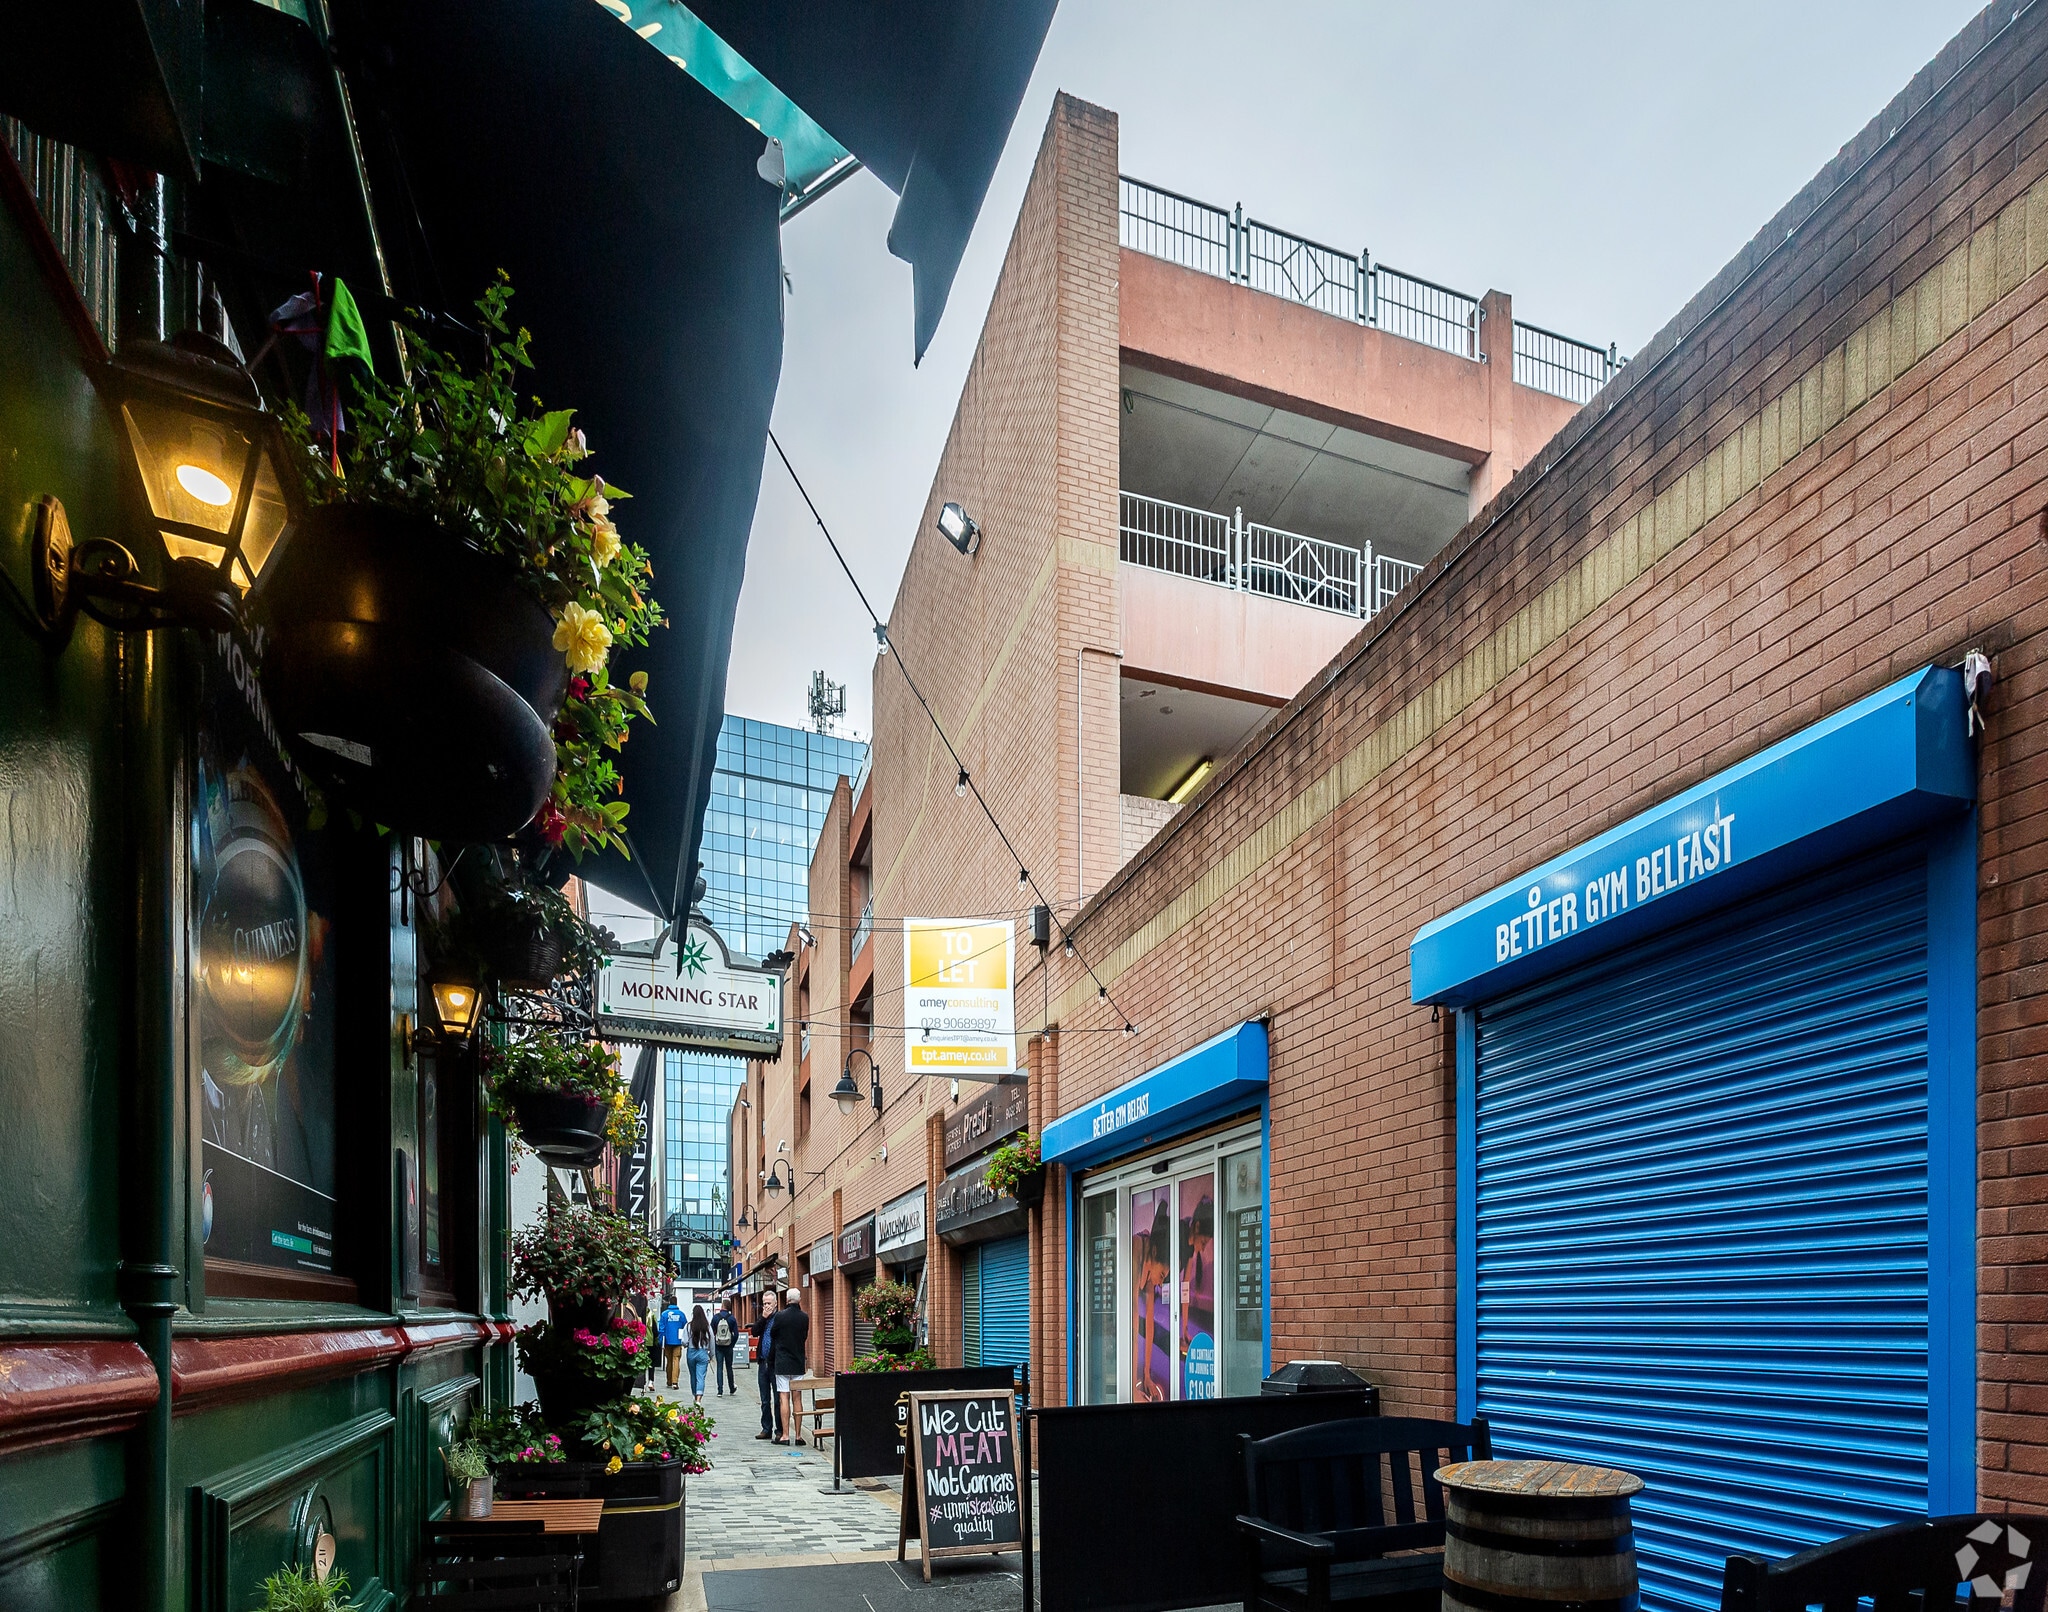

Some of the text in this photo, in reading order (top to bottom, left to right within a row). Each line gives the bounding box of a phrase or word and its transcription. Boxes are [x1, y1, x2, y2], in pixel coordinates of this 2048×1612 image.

[1496, 813, 1735, 963] BETTER GYM BELFAST
[941, 931, 973, 955] TO
[938, 959, 979, 983] LET
[621, 981, 758, 1010] MORNING STAR
[919, 997, 999, 1011] ameyconsulting
[920, 1017, 997, 1030] 028 90689897
[921, 1049, 997, 1063] tpt.amey.co.uk
[1093, 1092, 1150, 1138] BETTER GYM BELFAST
[921, 1400, 1005, 1436] We Cut
[936, 1431, 1008, 1467] MEAT
[953, 1516, 994, 1541] quality
